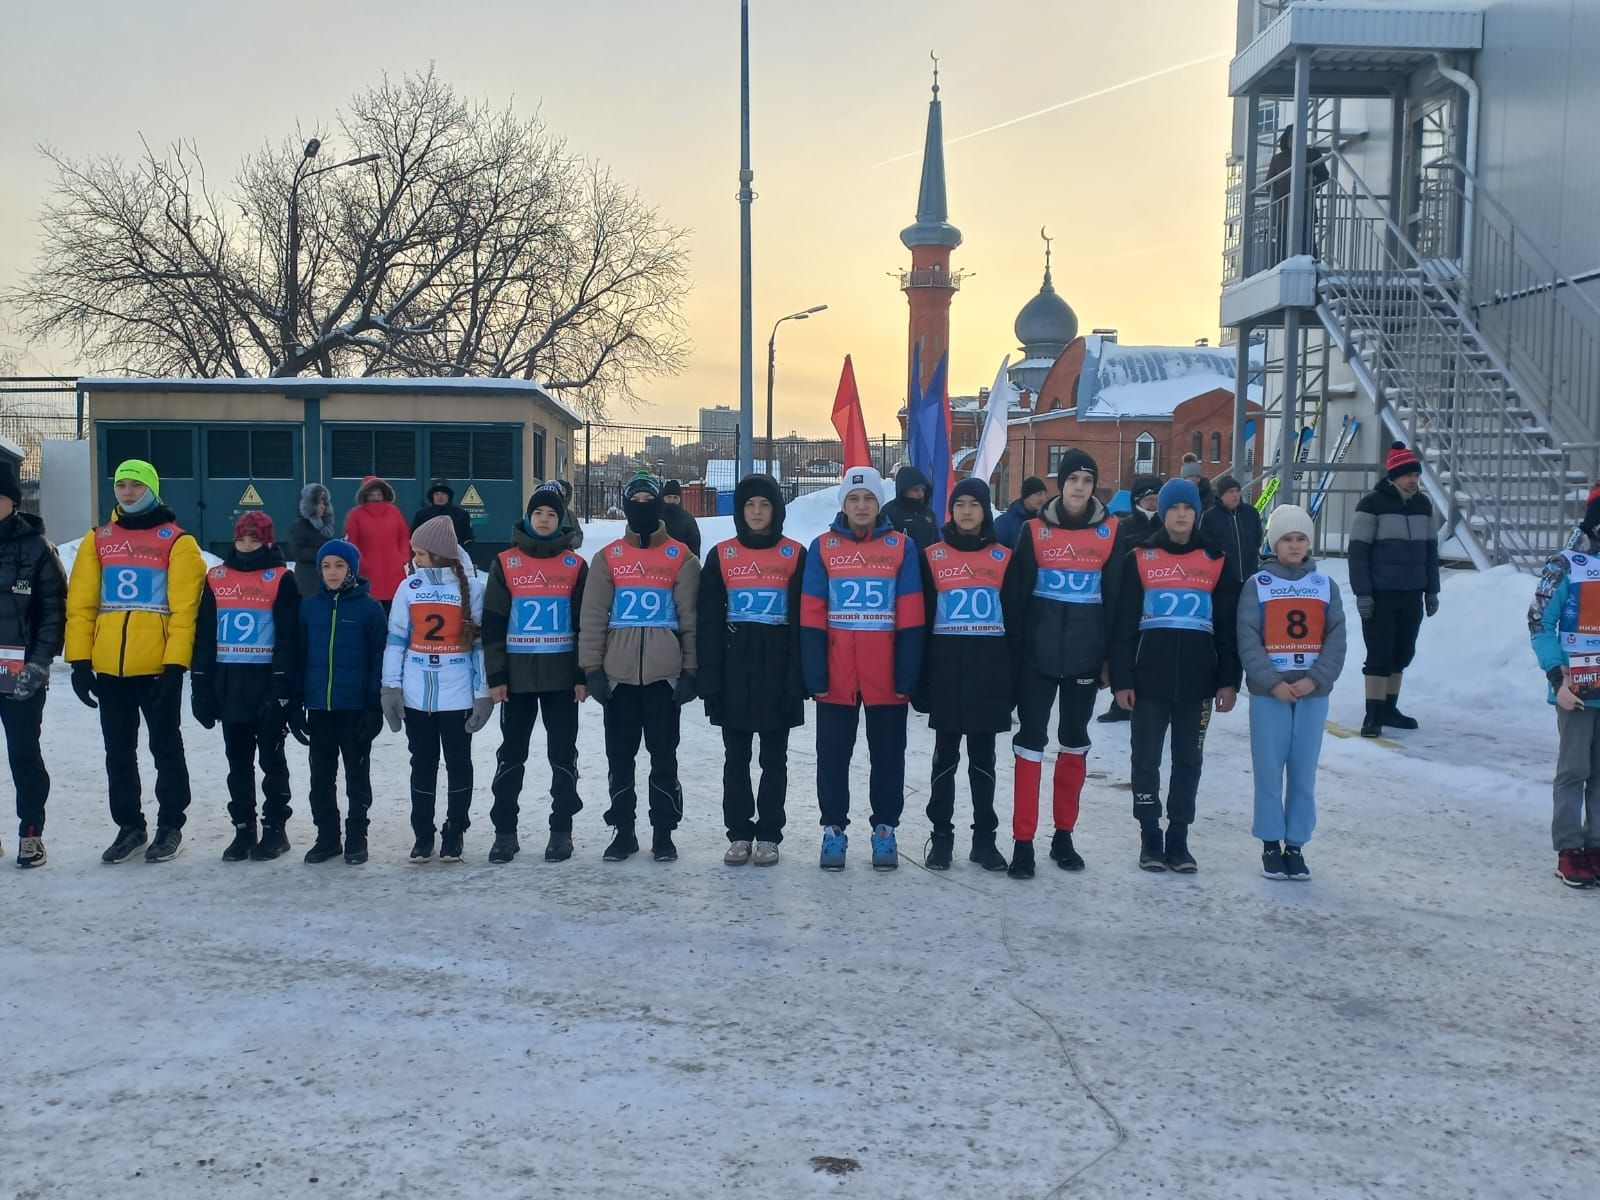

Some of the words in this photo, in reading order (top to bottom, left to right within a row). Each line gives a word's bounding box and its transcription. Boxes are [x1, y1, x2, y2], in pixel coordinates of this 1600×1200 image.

[1256, 478, 1280, 511] SCHER
[117, 569, 139, 600] 8
[840, 581, 884, 607] 25
[522, 600, 559, 631] 21
[621, 590, 661, 620] 29
[738, 591, 778, 615] 27
[949, 588, 992, 620] 20
[1159, 592, 1201, 617] 22
[220, 612, 255, 642] 19
[424, 614, 445, 641] 2
[1286, 609, 1308, 639] 8
